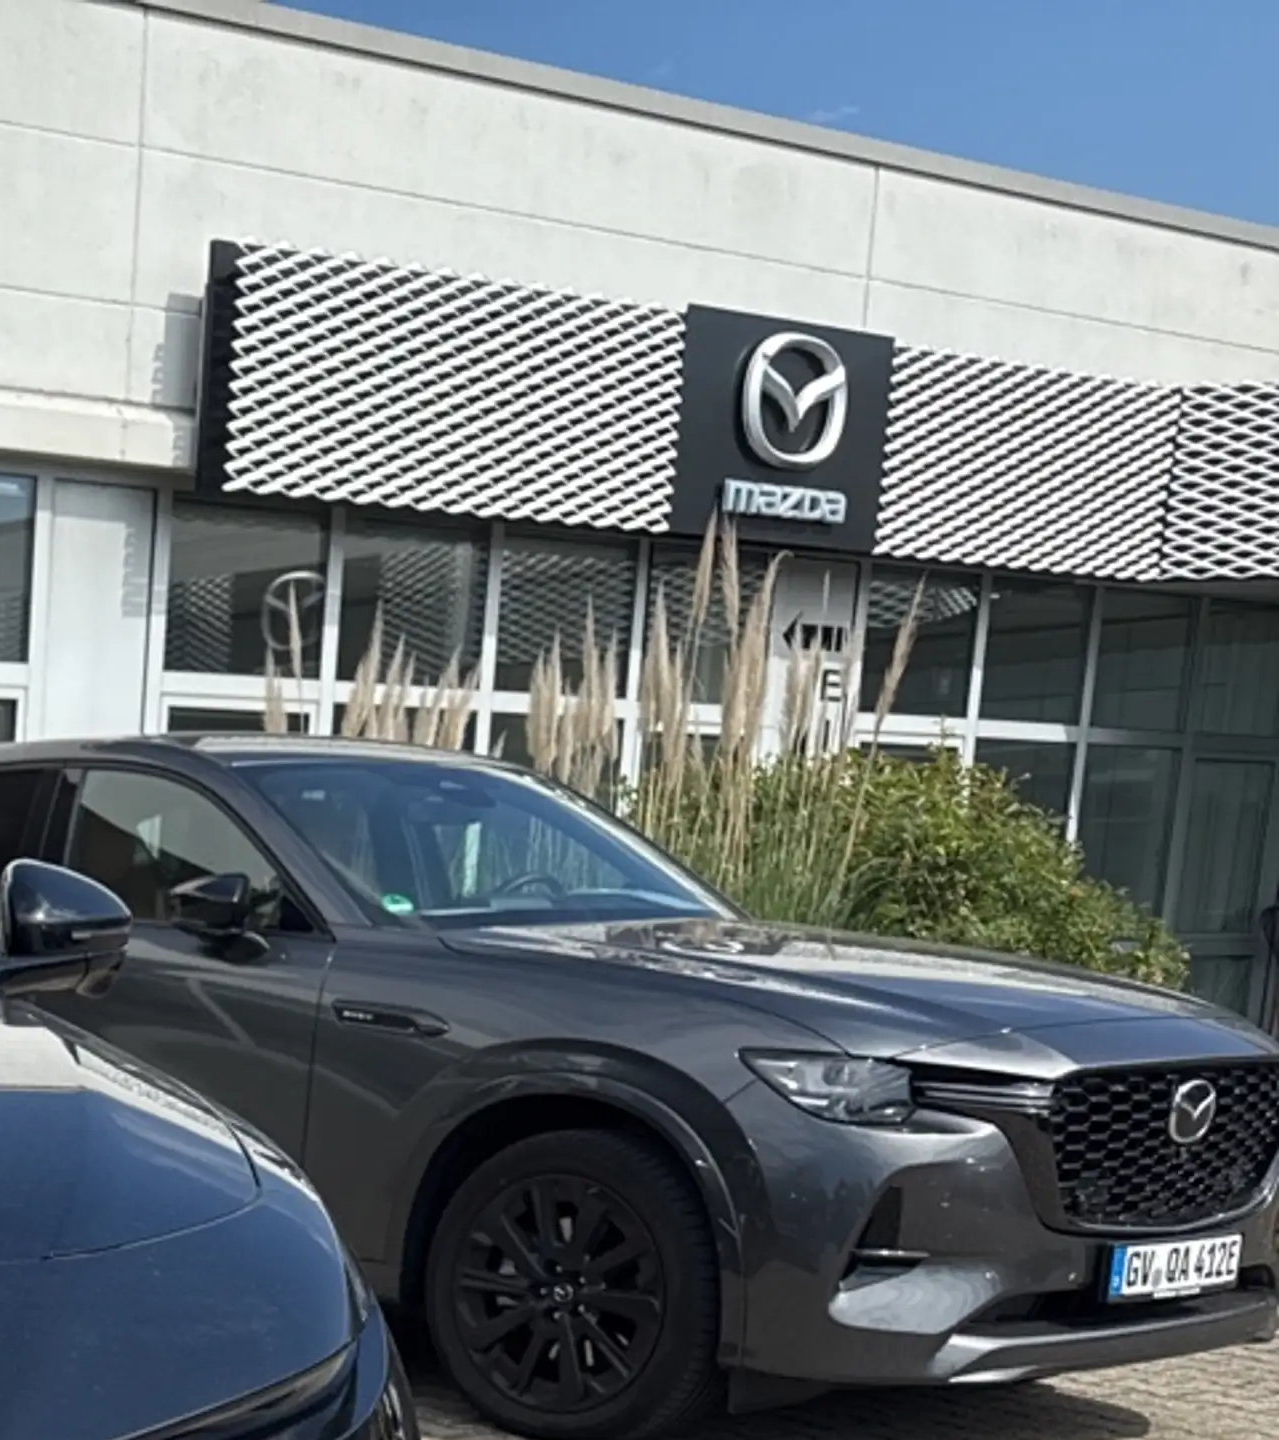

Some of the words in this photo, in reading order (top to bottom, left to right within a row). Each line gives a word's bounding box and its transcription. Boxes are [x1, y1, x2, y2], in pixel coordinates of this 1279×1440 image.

[722, 478, 847, 524] mazda
[1126, 1250, 1155, 1287] GV
[1194, 1240, 1239, 1279] 412E
